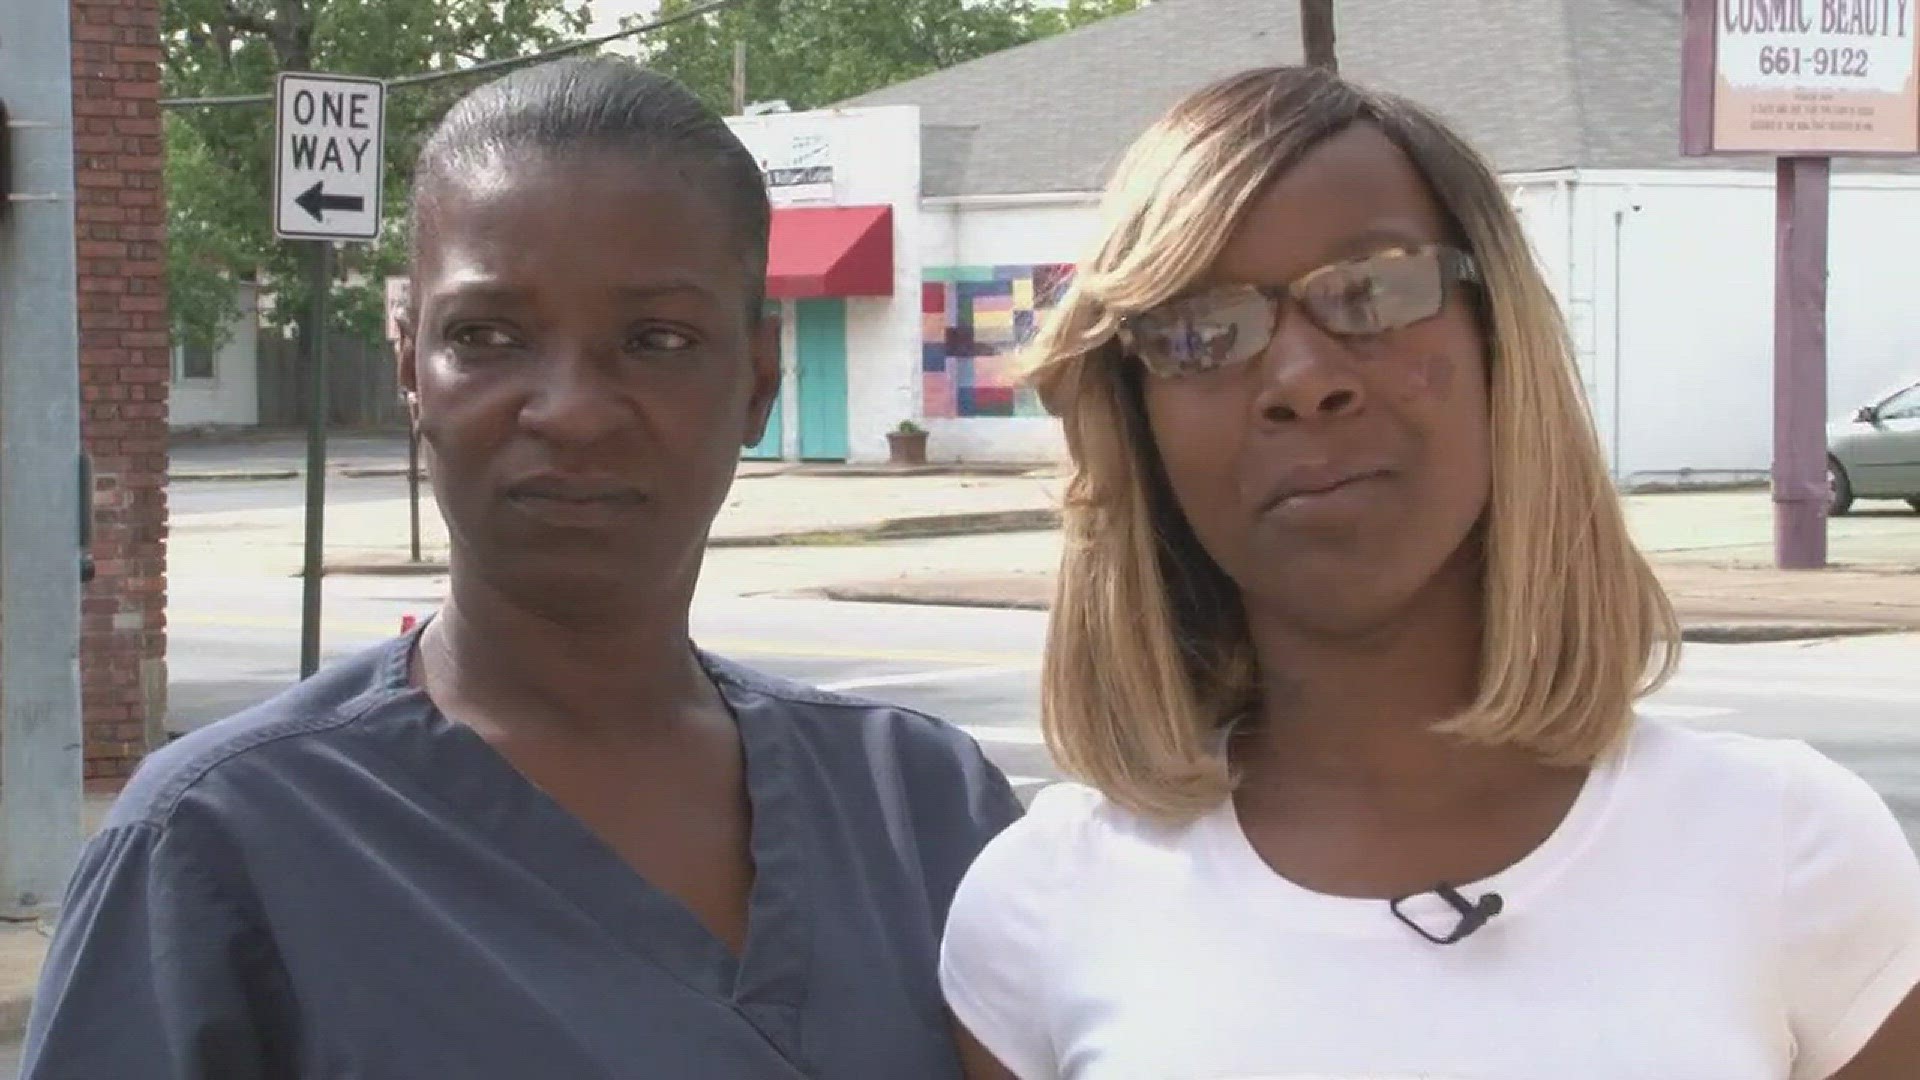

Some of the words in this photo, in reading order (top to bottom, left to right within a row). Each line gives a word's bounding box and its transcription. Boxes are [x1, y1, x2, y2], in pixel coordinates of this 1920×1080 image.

[1724, 0, 1812, 34] COSMIC
[1821, 0, 1907, 37] BEAUTY
[1759, 46, 1869, 77] 661-9122
[294, 90, 368, 129] ONE
[292, 134, 371, 173] WAY
